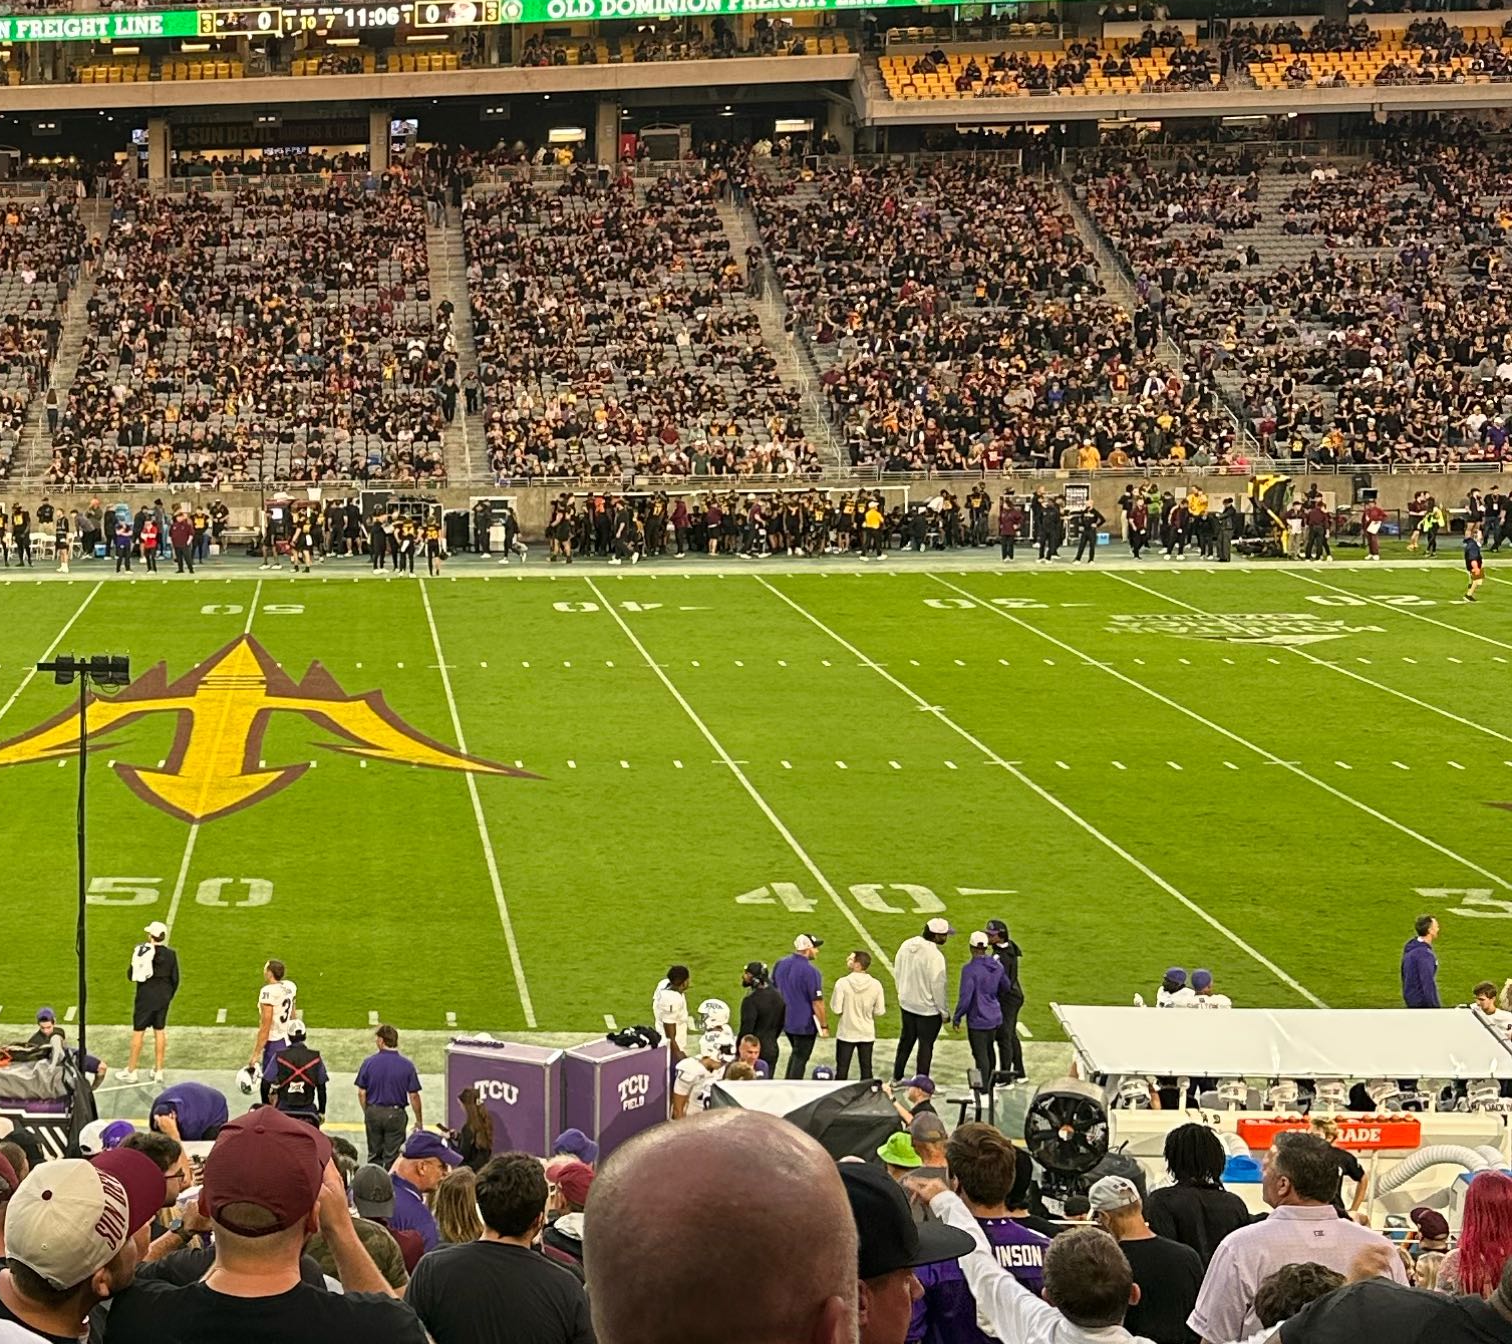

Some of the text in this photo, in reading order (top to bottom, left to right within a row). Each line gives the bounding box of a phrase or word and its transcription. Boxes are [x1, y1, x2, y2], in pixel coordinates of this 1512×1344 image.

[258, 11, 271, 30] 0
[300, 17, 316, 29] 10
[345, 7, 399, 27] 11:06
[426, 4, 439, 23] 0
[16, 18, 109, 39] FREIGHT
[114, 15, 163, 36] LINE
[187, 127, 225, 144] SUN
[227, 126, 274, 144] DEVIL
[201, 604, 306, 615] 50
[553, 601, 663, 612] 40
[85, 876, 273, 907] 50
[735, 881, 947, 914] 40
[473, 1079, 519, 1106] TCU
[618, 1074, 650, 1102] TCU
[623, 1095, 645, 1112] FIELD
[95, 1200, 126, 1251] SUN
[995, 1244, 1043, 1268] INSON
